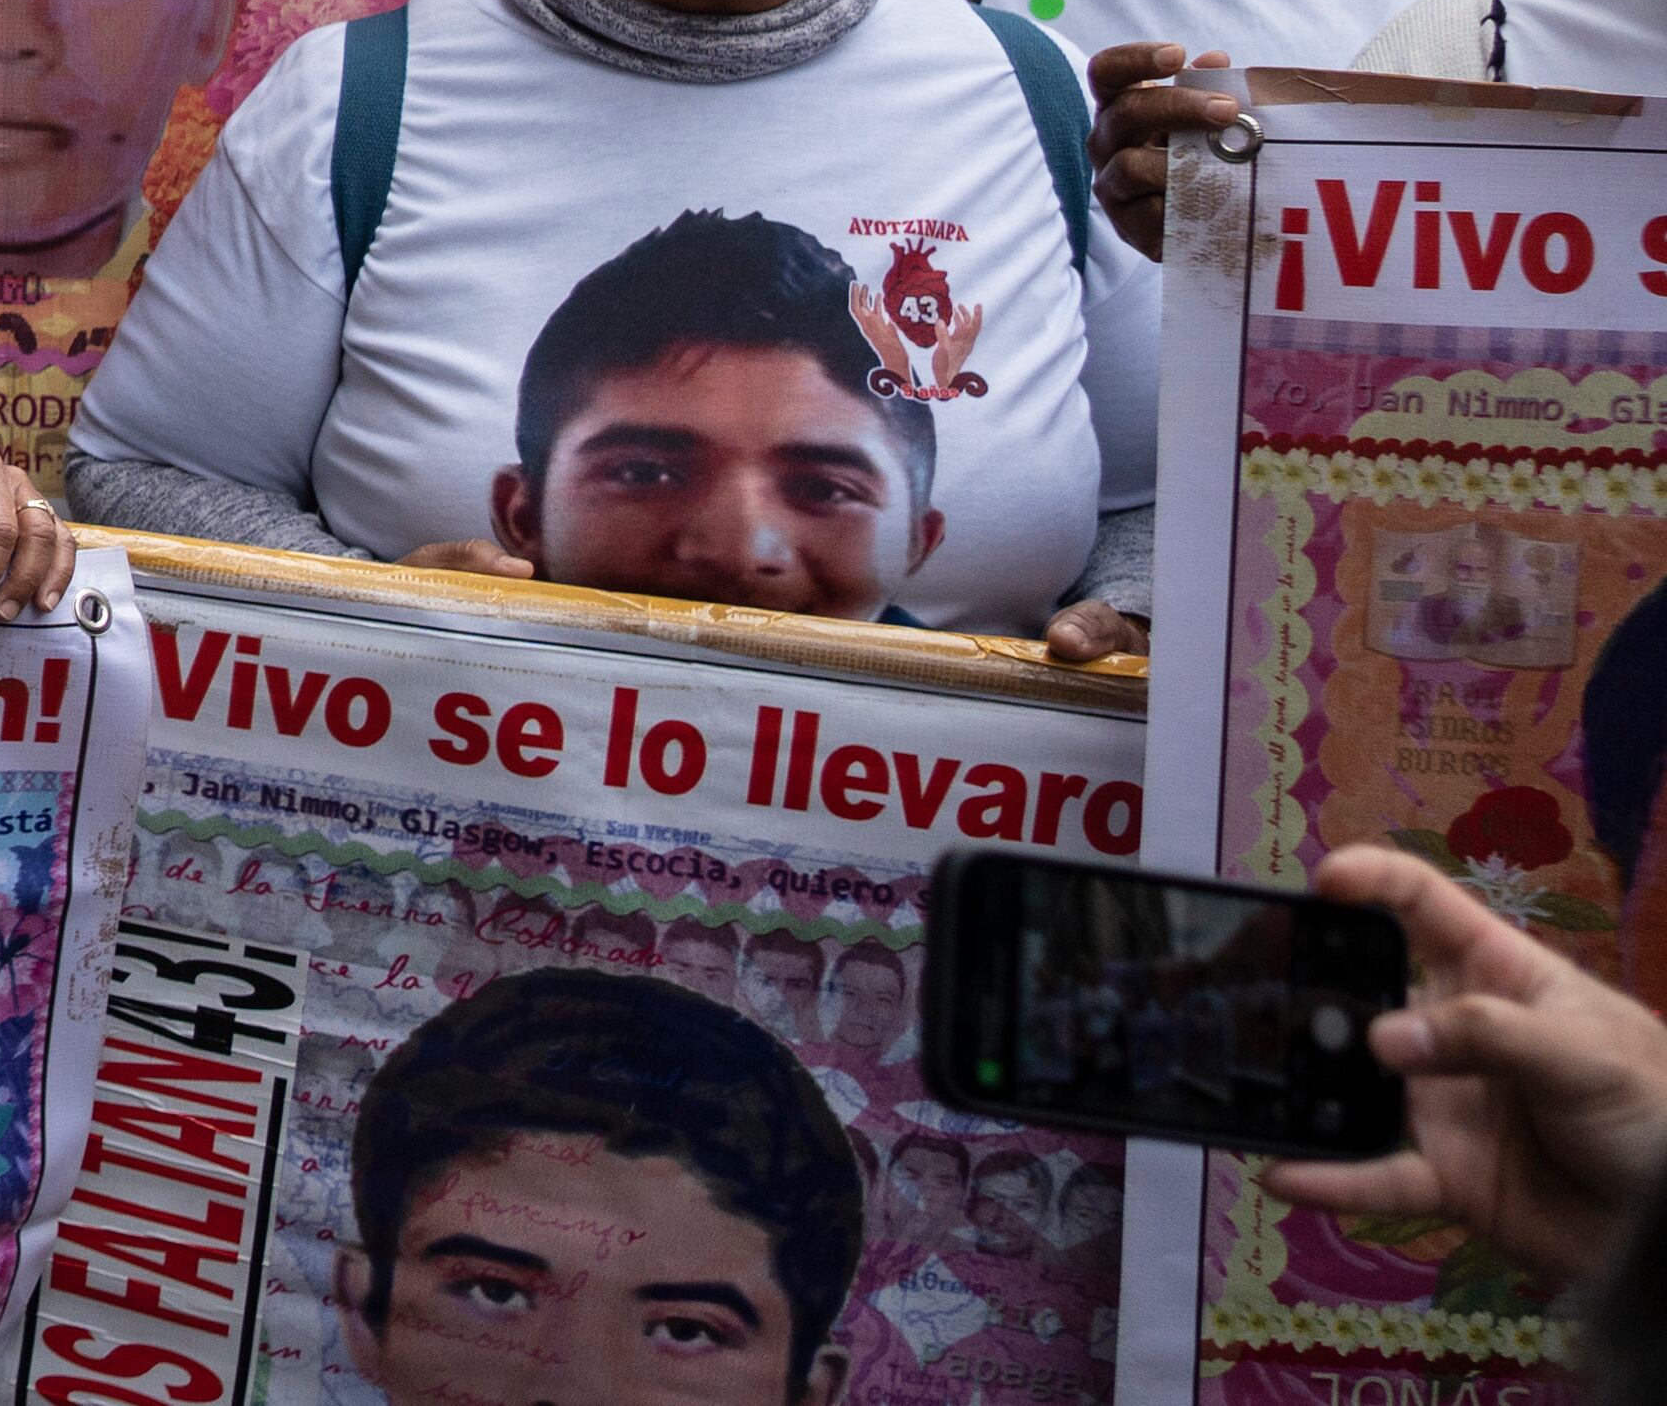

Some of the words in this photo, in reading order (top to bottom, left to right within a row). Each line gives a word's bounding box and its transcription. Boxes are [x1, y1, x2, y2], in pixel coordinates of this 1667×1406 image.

[847, 216, 970, 242] AYOTZINAPA
[1274, 178, 1596, 313] ¡Vivo
[899, 294, 941, 325] 43
[1356, 384, 1425, 415] Jan
[1447, 387, 1580, 425] Nimmo,
[149, 622, 393, 749] Vivo
[427, 691, 565, 779] se
[603, 686, 708, 796] lo
[746, 704, 1145, 857] llevaro
[181, 771, 240, 802] Jan
[259, 784, 378, 831] Nimmo,
[400, 807, 558, 866] Glasgow,
[585, 840, 743, 891] Escocia,
[768, 867, 895, 910] quiero
[49, 1036, 264, 1338] FALTAN
